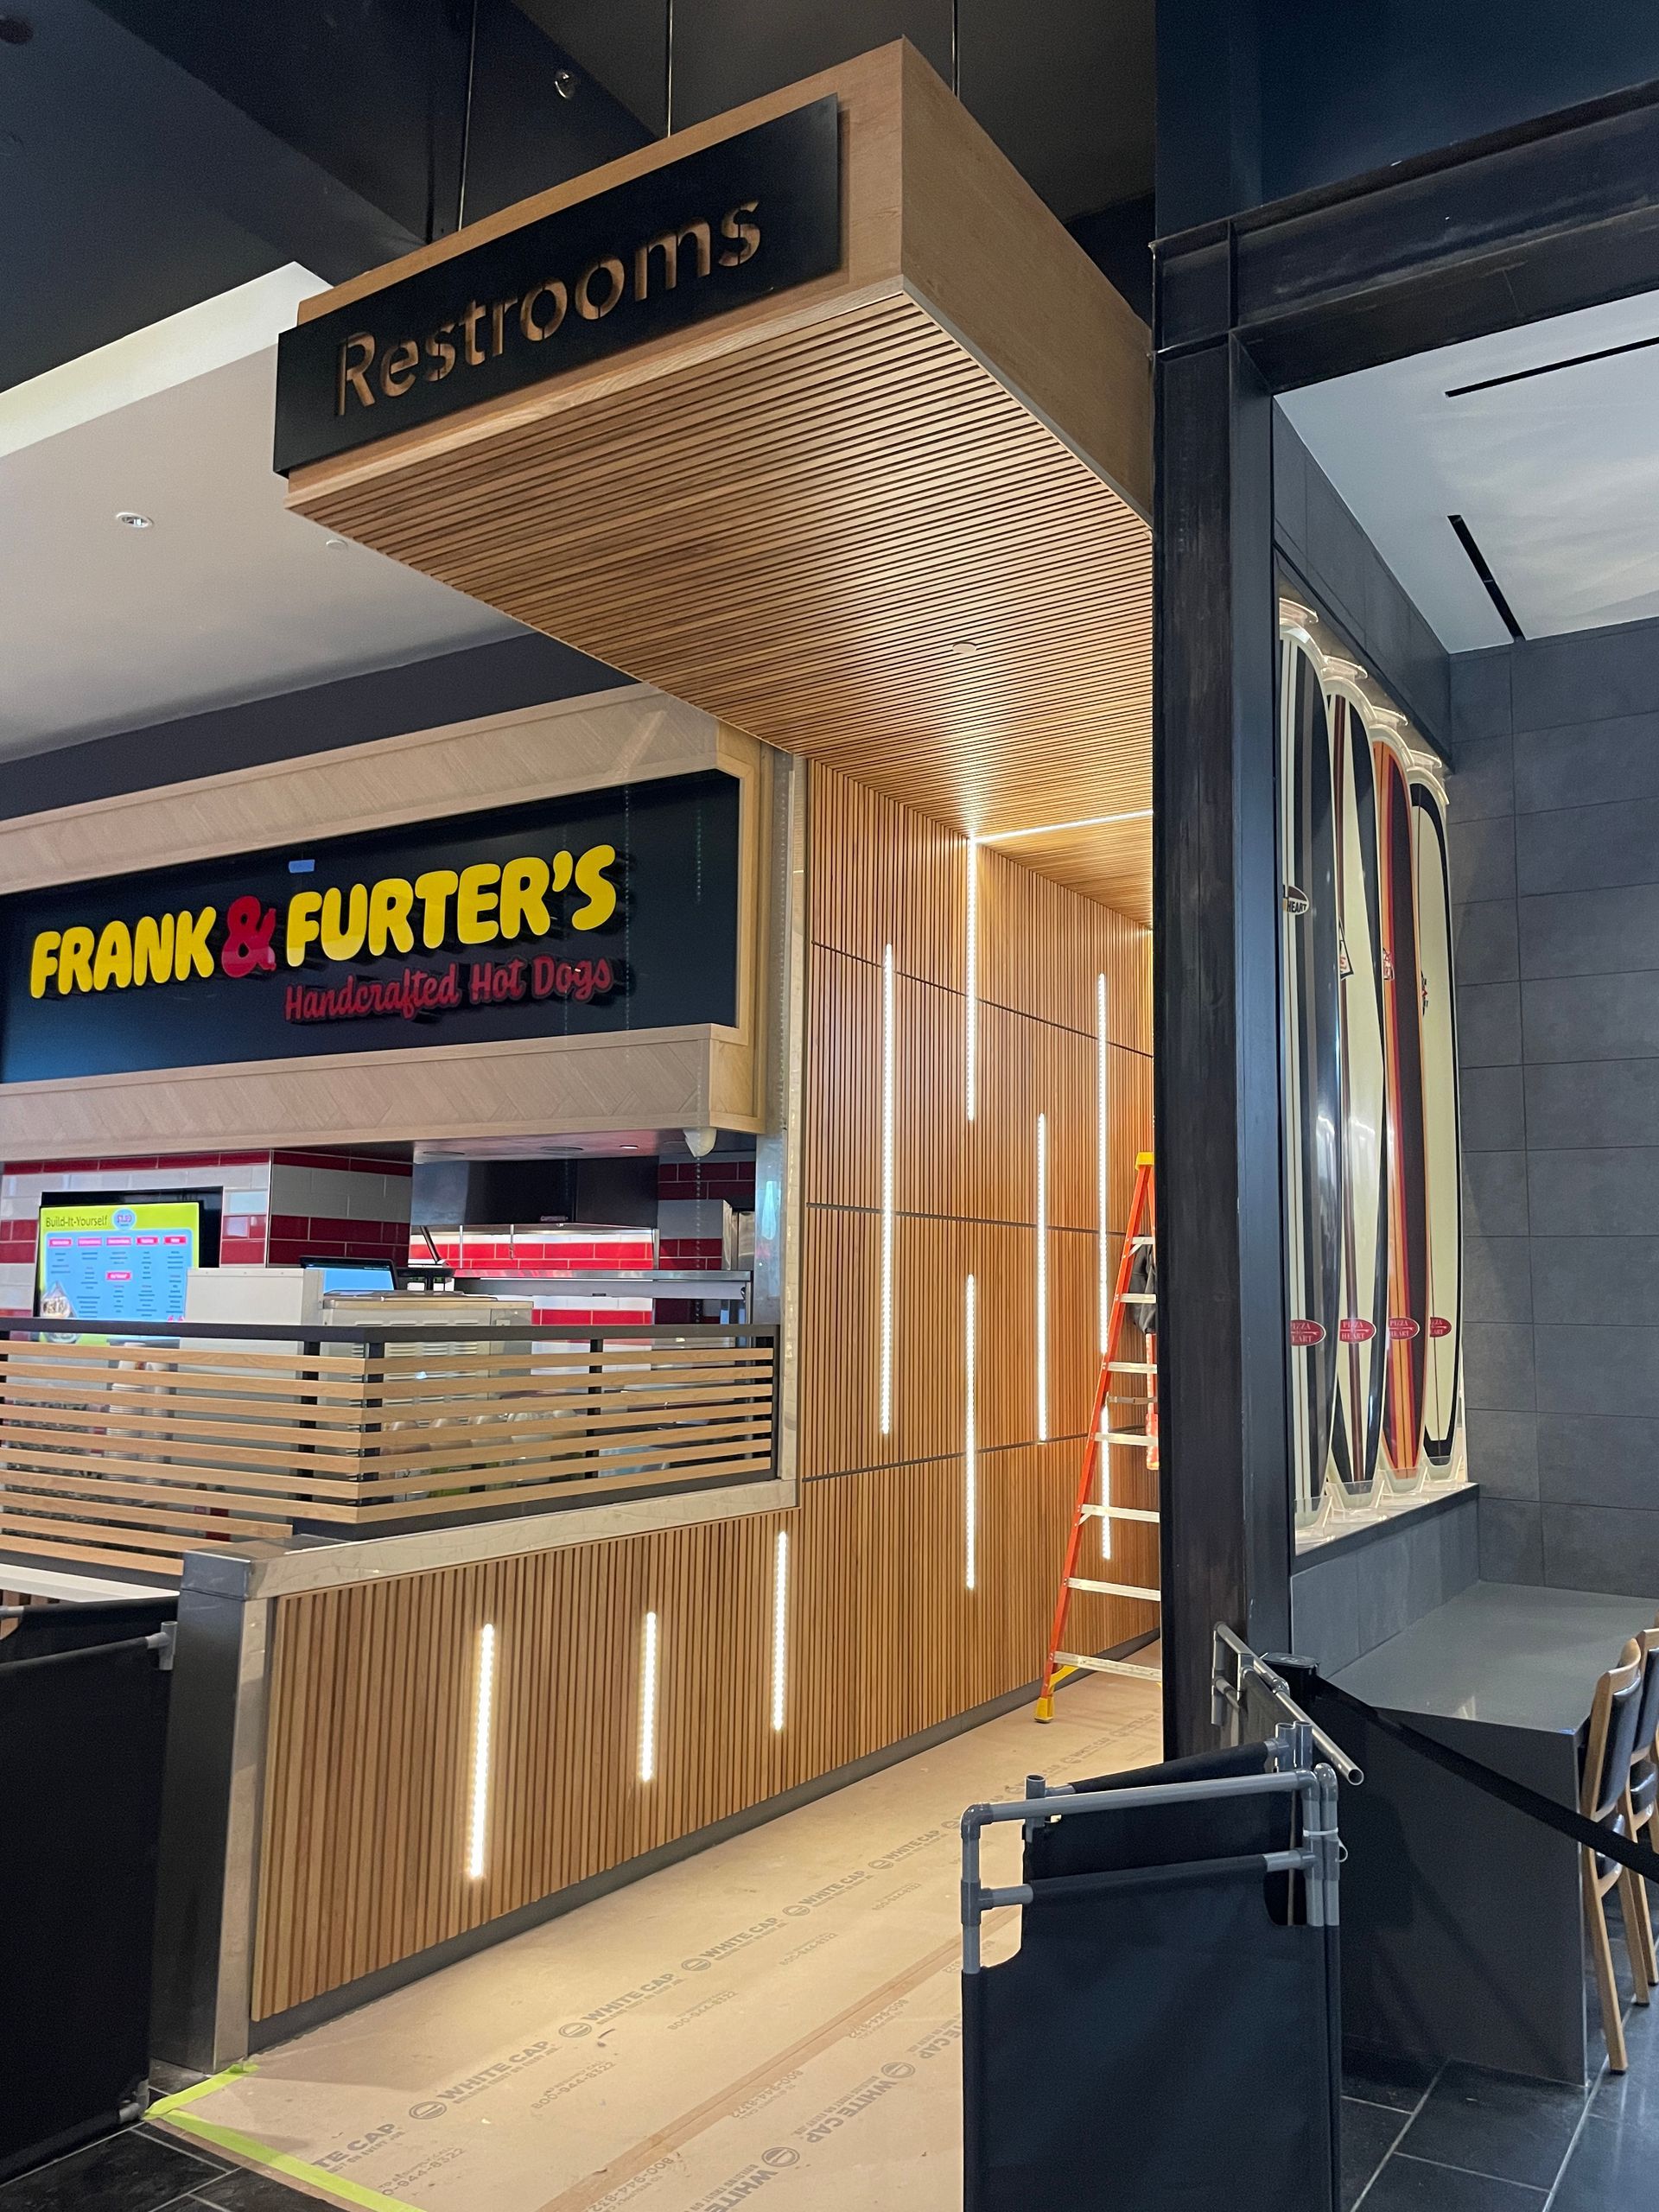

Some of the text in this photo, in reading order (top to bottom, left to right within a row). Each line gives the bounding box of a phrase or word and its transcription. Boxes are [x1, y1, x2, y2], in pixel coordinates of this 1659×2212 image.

[334, 197, 762, 417] Restrooms
[30, 843, 617, 1000] FRANK & FURTER'S
[284, 953, 614, 1023] Handcrafted Hot Dogs
[46, 1215, 108, 1227] Build-It-Yourself
[1291, 1334, 1313, 1343] EART
[1292, 1321, 1312, 1331] IZZA
[1342, 1320, 1364, 1329] PIZZA
[798, 1882, 843, 1906] WHITE
[840, 1870, 866, 1885] CAP
[699, 1931, 753, 1959] WHITE
[748, 1916, 779, 1934] CAP
[580, 1990, 644, 2022] WHITE
[640, 1973, 675, 1993] CAP
[918, 2037, 950, 2060] CAP
[436, 2062, 512, 2101] WHITE
[508, 2040, 550, 2063] CAP
[836, 2080, 898, 2118] WHITE
[346, 2123, 397, 2152] CAP
[806, 2117, 844, 2143] CAP
[381, 2147, 466, 2196] 0-944-8322
[588, 2157, 674, 2212] 800-944-832
[704, 2170, 779, 2212] WHITE
